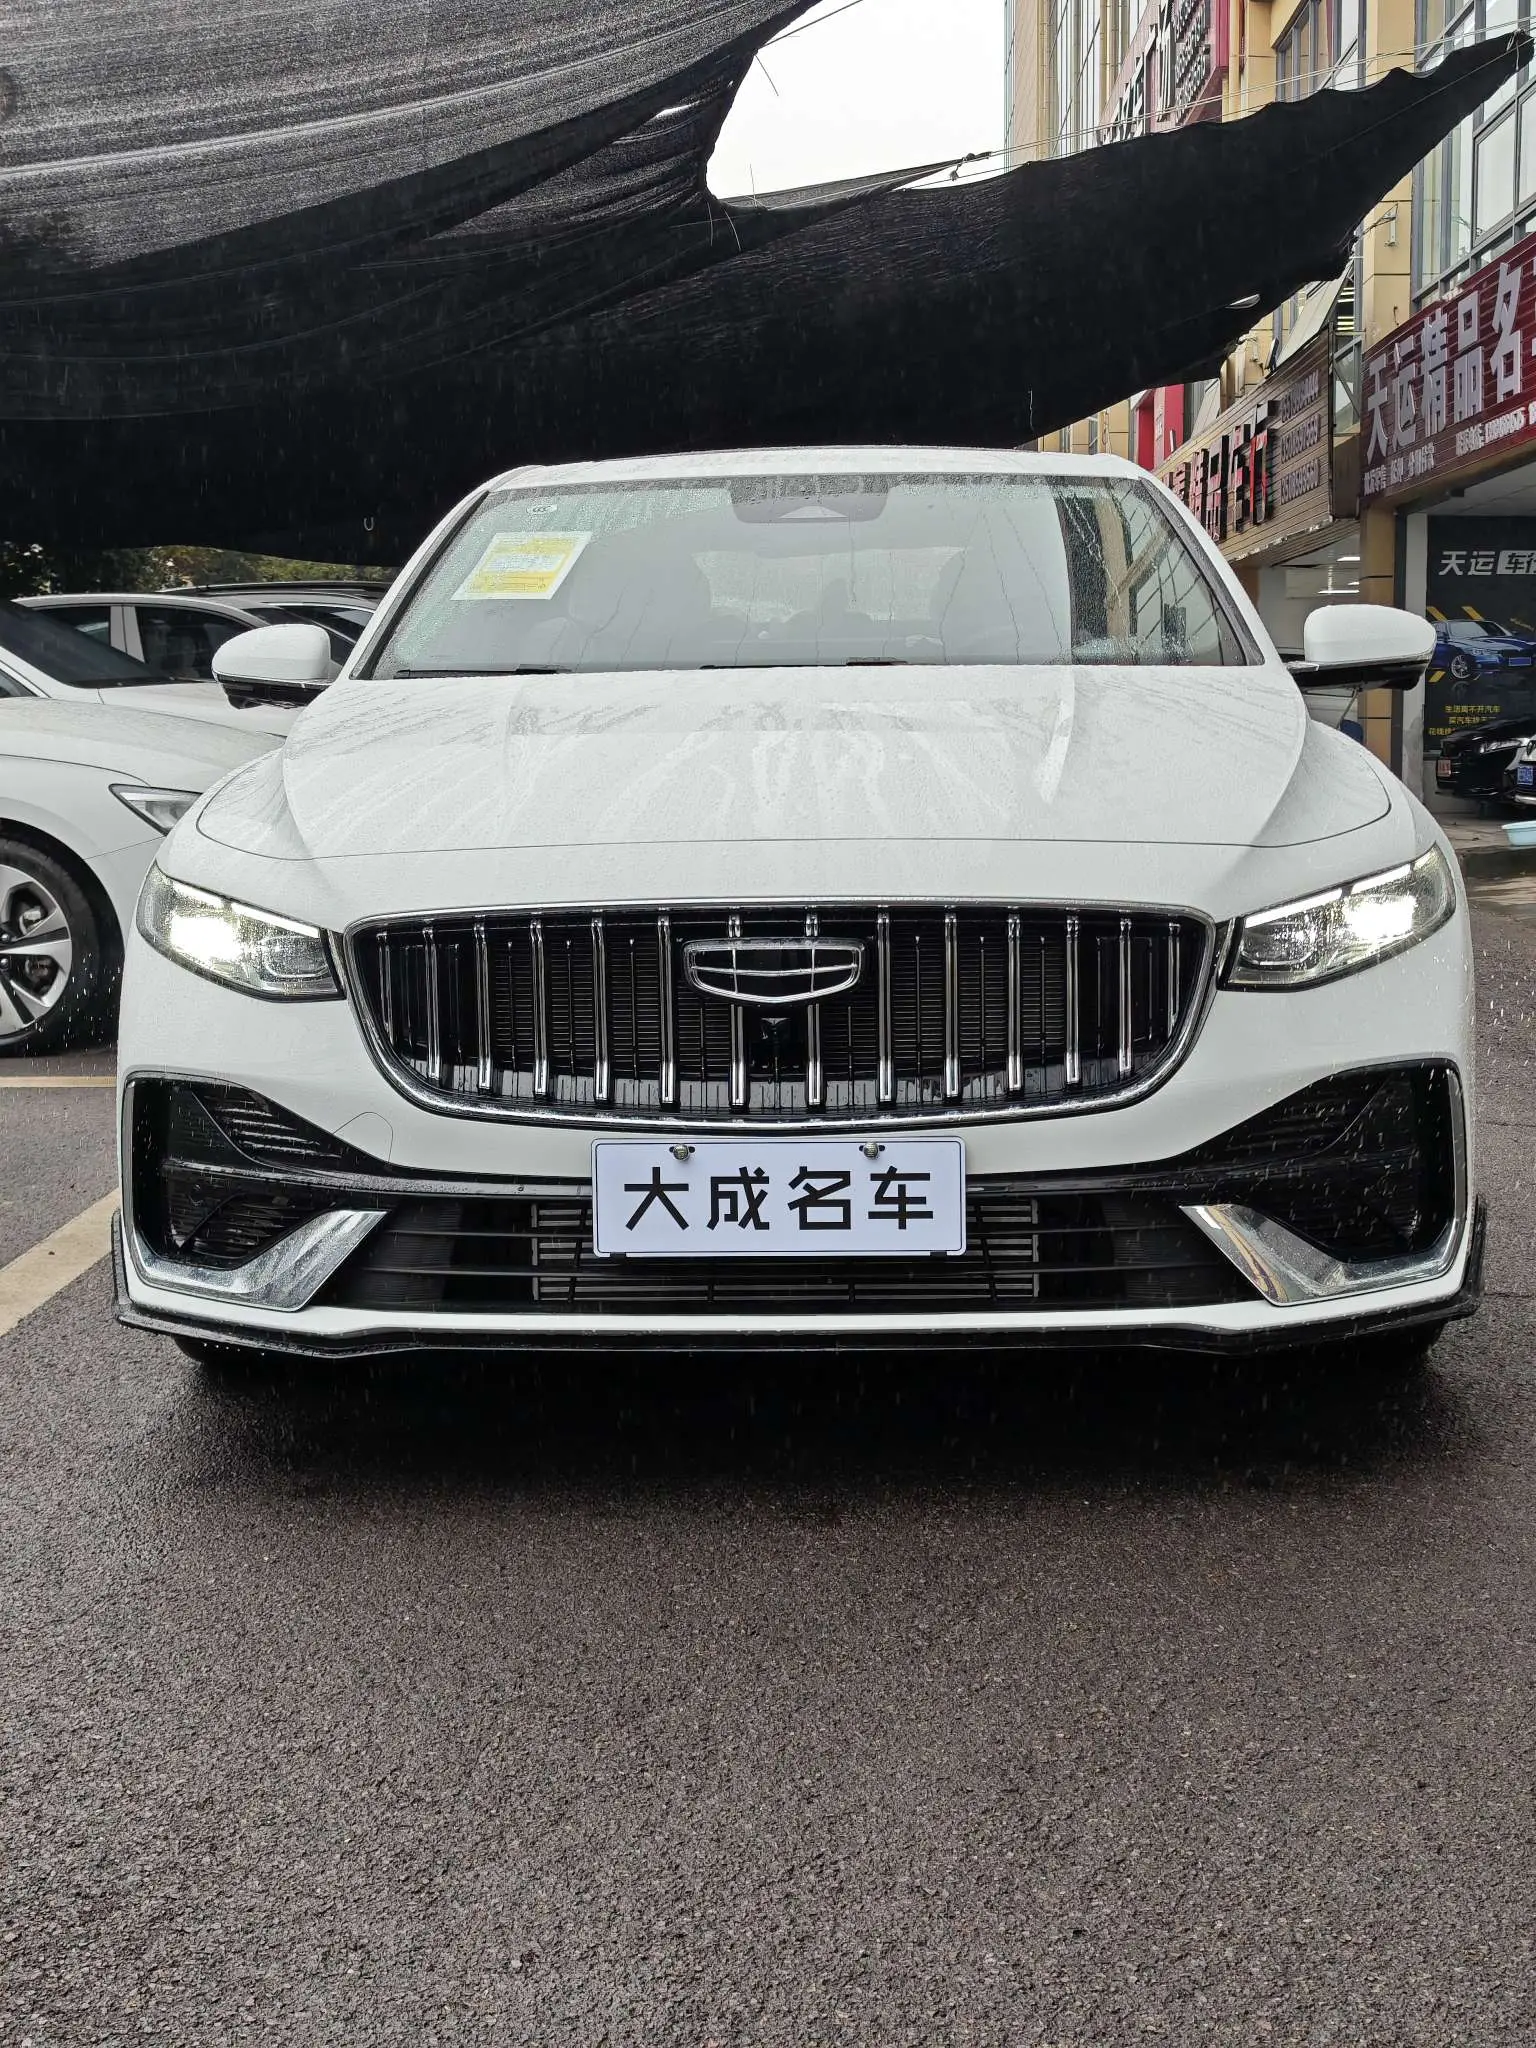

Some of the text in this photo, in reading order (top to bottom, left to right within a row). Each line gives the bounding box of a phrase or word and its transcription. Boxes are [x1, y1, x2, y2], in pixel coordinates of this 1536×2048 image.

[1366, 256, 1536, 464] 天运精品名
[624, 1166, 933, 1231] 大成名车
